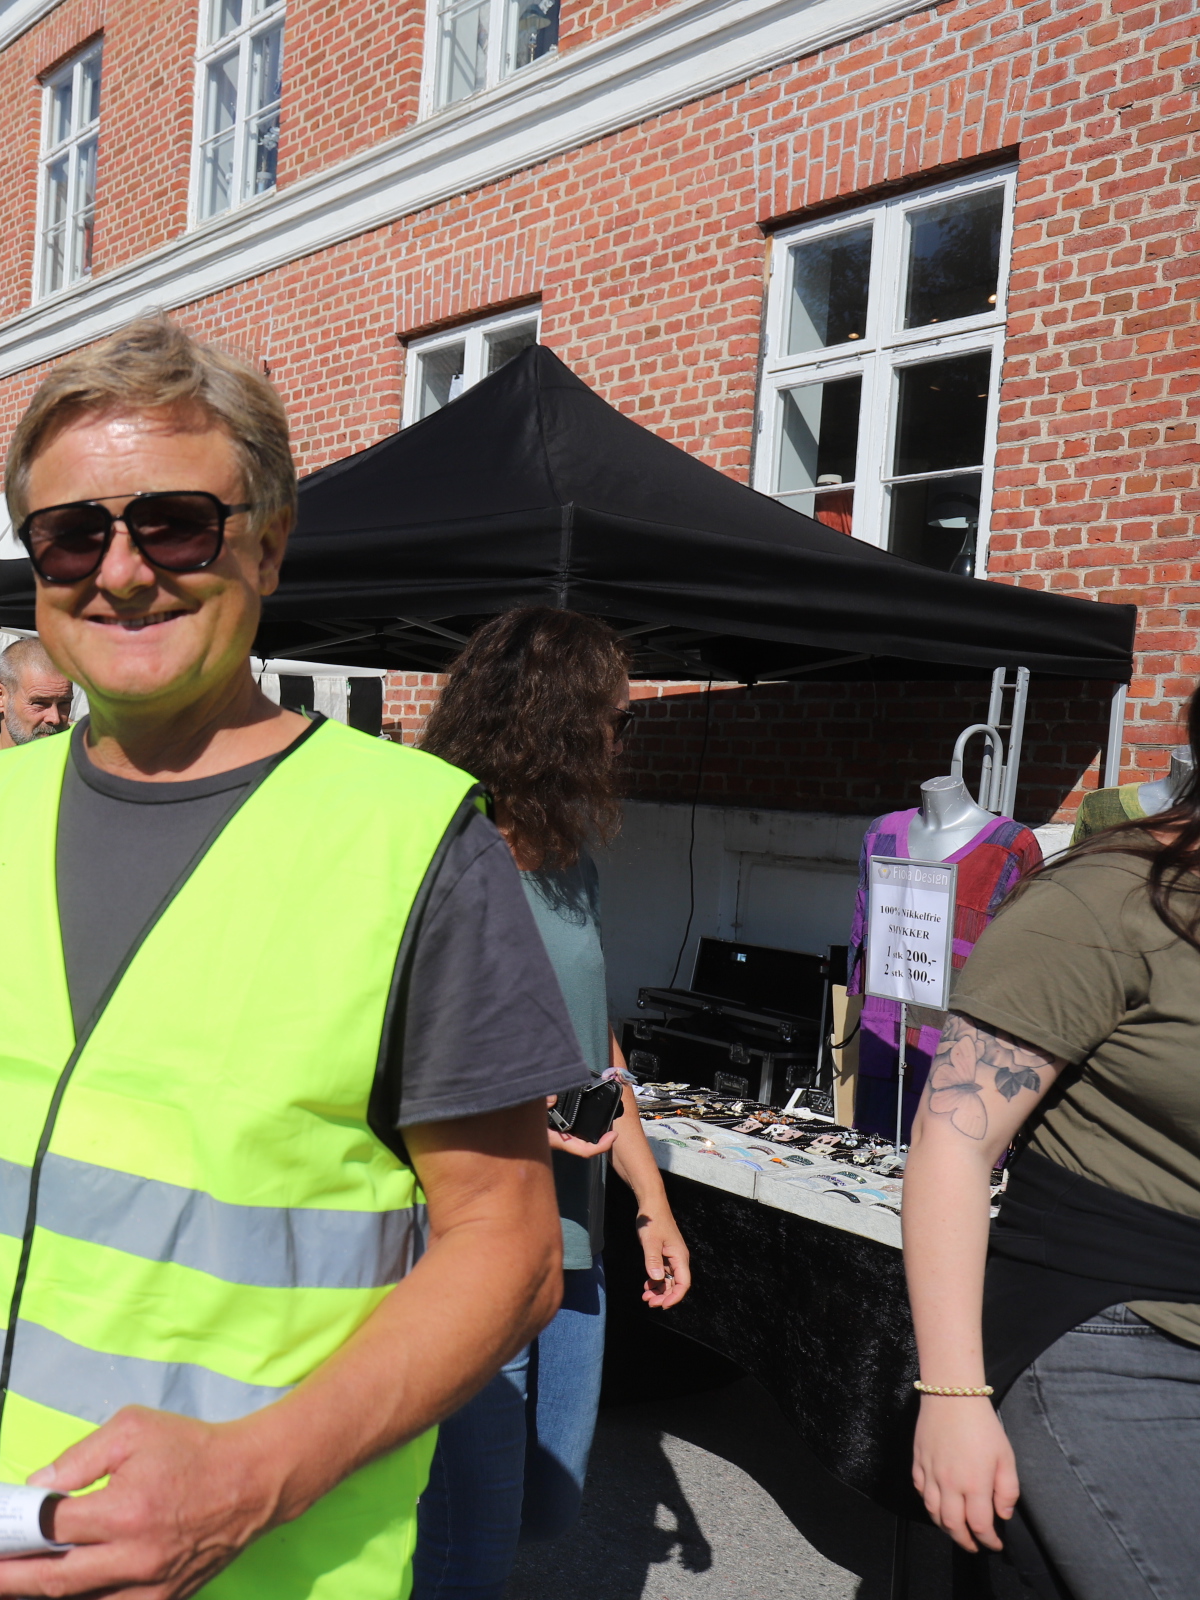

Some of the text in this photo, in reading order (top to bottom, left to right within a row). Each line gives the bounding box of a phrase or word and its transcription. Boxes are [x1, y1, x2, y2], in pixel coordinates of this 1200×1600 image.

[915, 869, 948, 886] Design
[880, 905, 941, 923] 100% Nikkelfrie
[889, 924, 930, 940] SMYKKER
[887, 945, 937, 967] 1 stk 200,-
[884, 964, 936, 986] 2 stk 300,-
